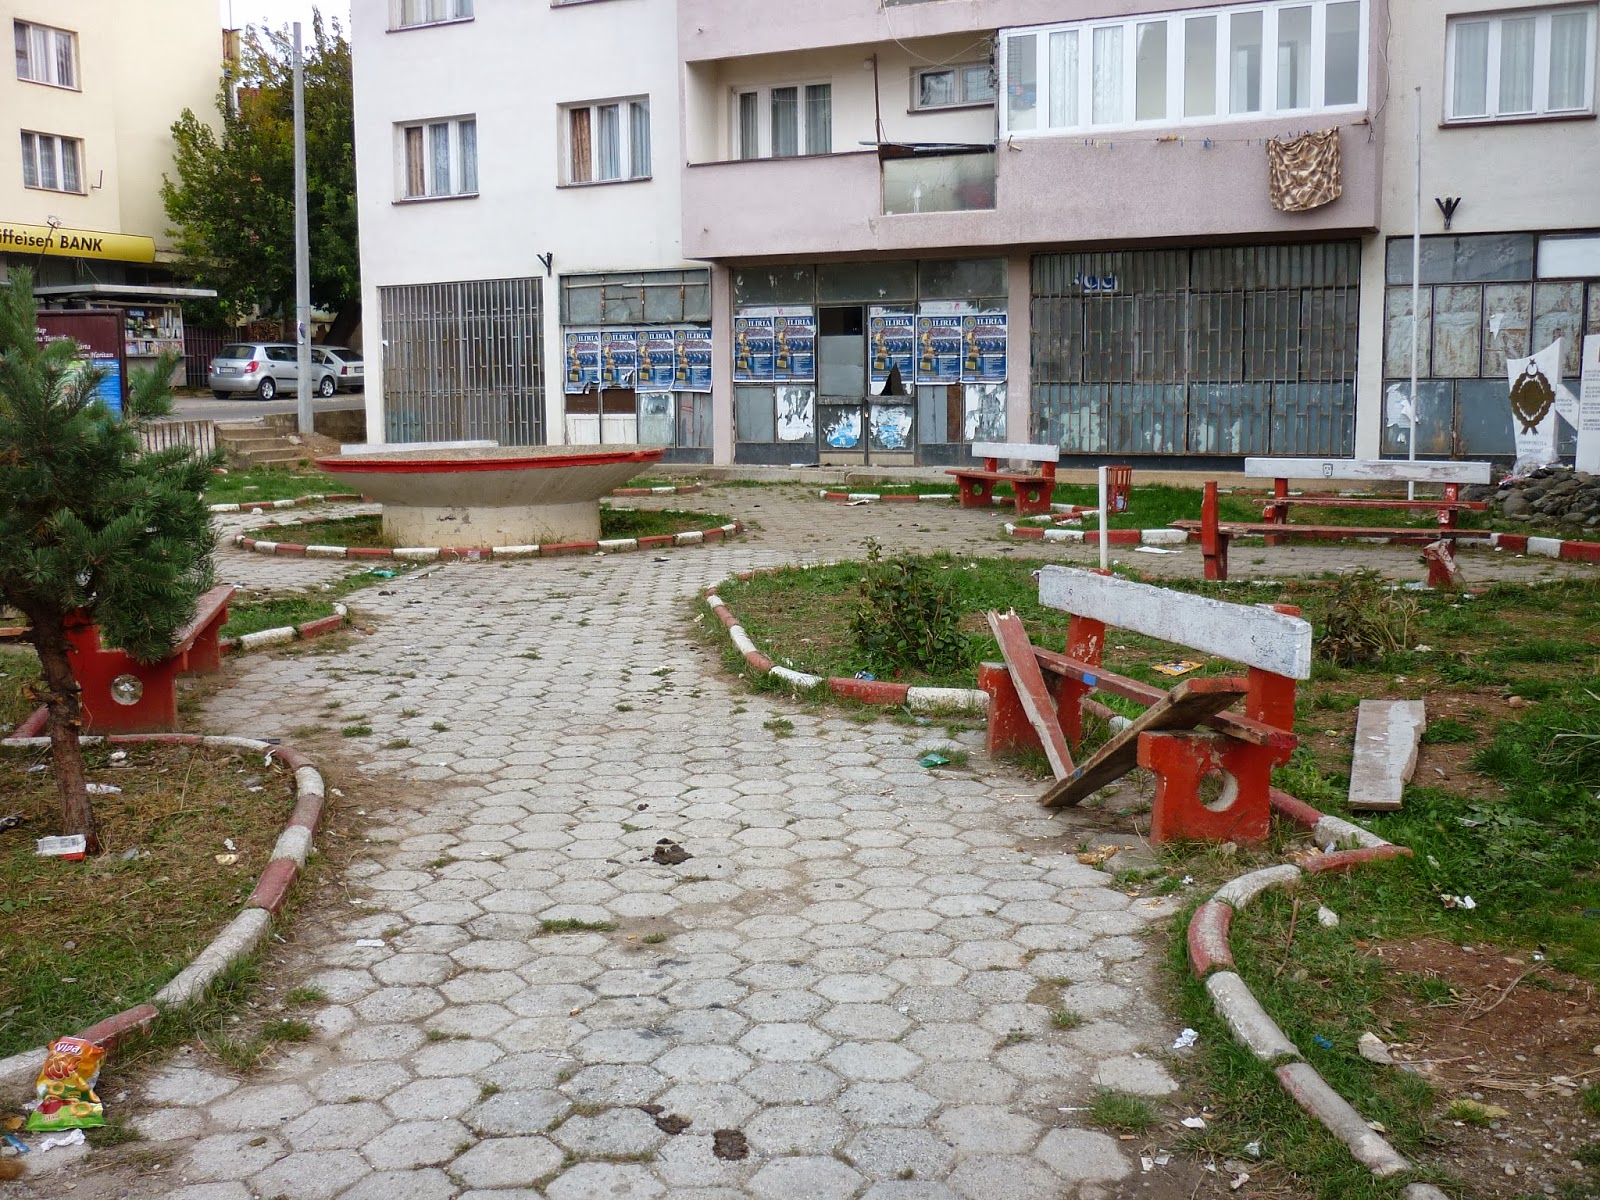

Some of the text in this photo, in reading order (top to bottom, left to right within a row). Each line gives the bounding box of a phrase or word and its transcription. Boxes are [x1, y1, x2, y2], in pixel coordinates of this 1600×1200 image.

[60, 235, 103, 252] BANK
[885, 318, 910, 326] ILIRIA
[976, 317, 1003, 325] ILIRIA
[686, 332, 709, 340] ILIRIA
